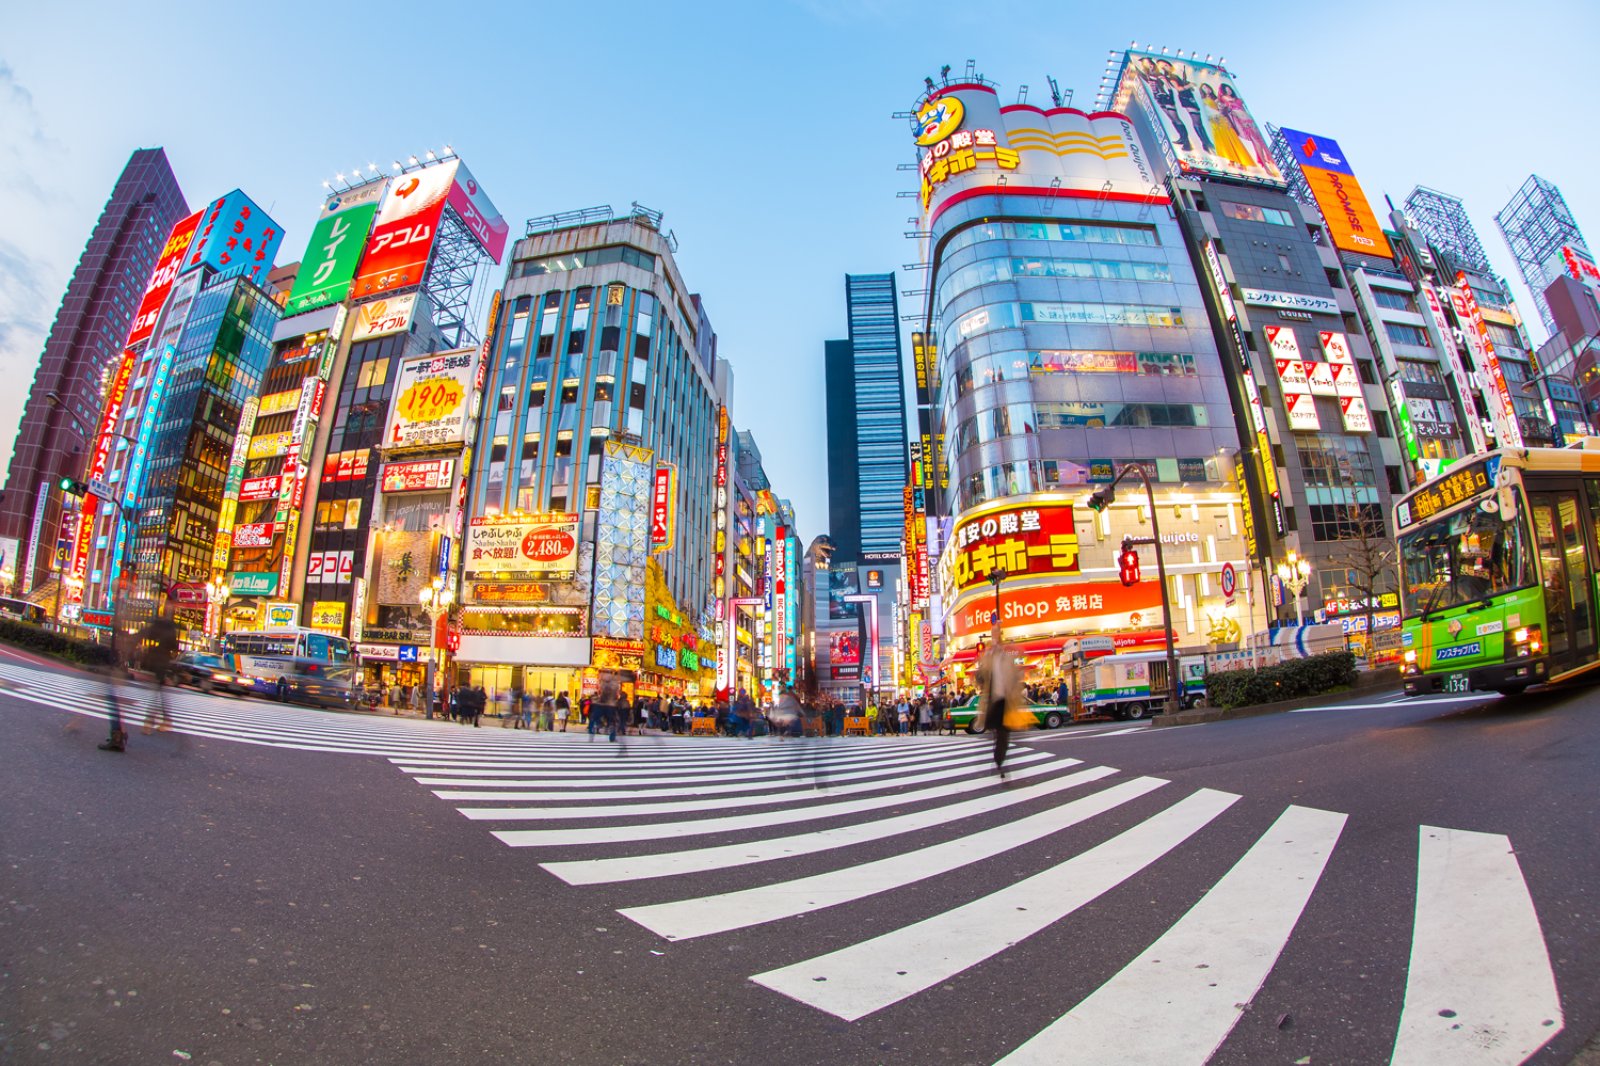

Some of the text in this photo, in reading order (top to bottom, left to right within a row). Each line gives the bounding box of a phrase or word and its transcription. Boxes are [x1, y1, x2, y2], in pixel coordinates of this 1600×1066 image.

[920, 128, 997, 180] 安の殿堂
[1120, 121, 1150, 183] Don Quijote
[1326, 172, 1364, 233] PROMISE
[463, 202, 489, 243] アコム
[370, 222, 431, 255] アコム
[312, 217, 352, 287] レイク
[1246, 292, 1338, 309] エンタメ レストランタワー
[367, 316, 406, 334] アイフル
[407, 383, 459, 411] 190円
[93, 403, 121, 482] エスパス日
[339, 454, 368, 470] アイフル
[440, 477, 449, 485] 1F
[79, 514, 94, 553] パチンコ
[472, 527, 522, 539] しゃぶしゃぶ
[1158, 533, 1199, 546] uijote
[56, 547, 72, 561] GU
[526, 540, 562, 558] 2,480
[308, 555, 354, 574] アコム
[776, 540, 785, 581] SHIDAX
[1004, 600, 1050, 620] Shop
[1055, 594, 1104, 614] 免税店
[1325, 602, 1338, 613] 4F
[1342, 615, 1400, 634] ダイコドラッグ
[1437, 642, 1481, 660] ノンステップバス
